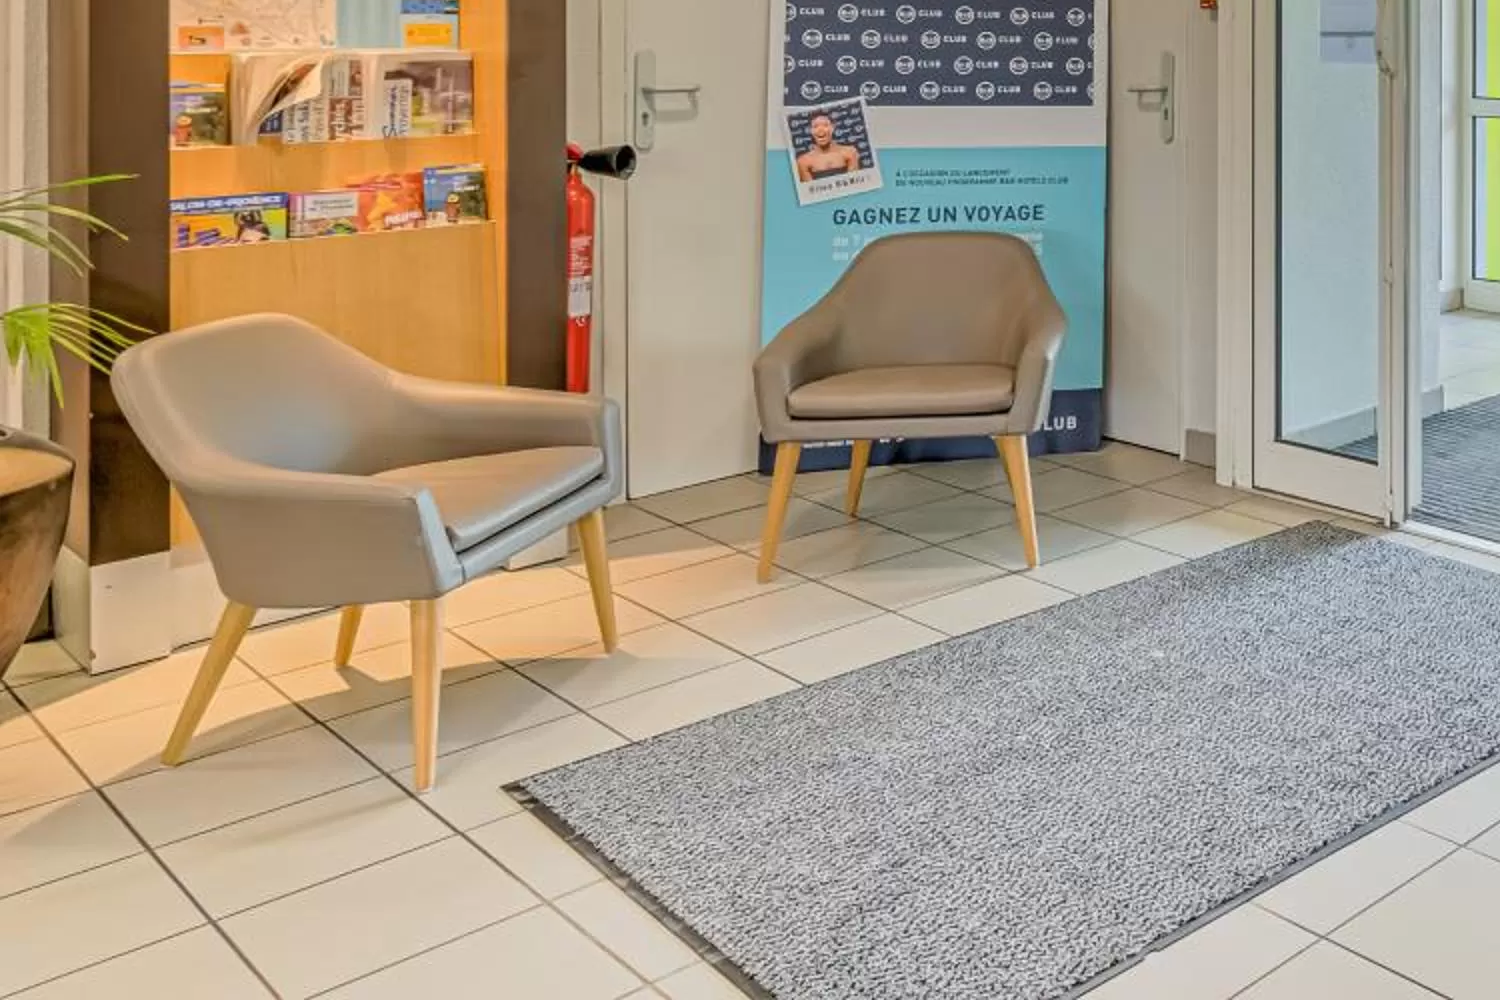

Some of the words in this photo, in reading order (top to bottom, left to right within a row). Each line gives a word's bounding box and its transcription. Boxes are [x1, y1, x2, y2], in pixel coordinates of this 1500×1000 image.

[833, 207, 921, 225] GAGNEZ
[928, 206, 956, 223] UN
[964, 204, 1044, 221] VOYAGE
[1043, 416, 1077, 431] LUB
